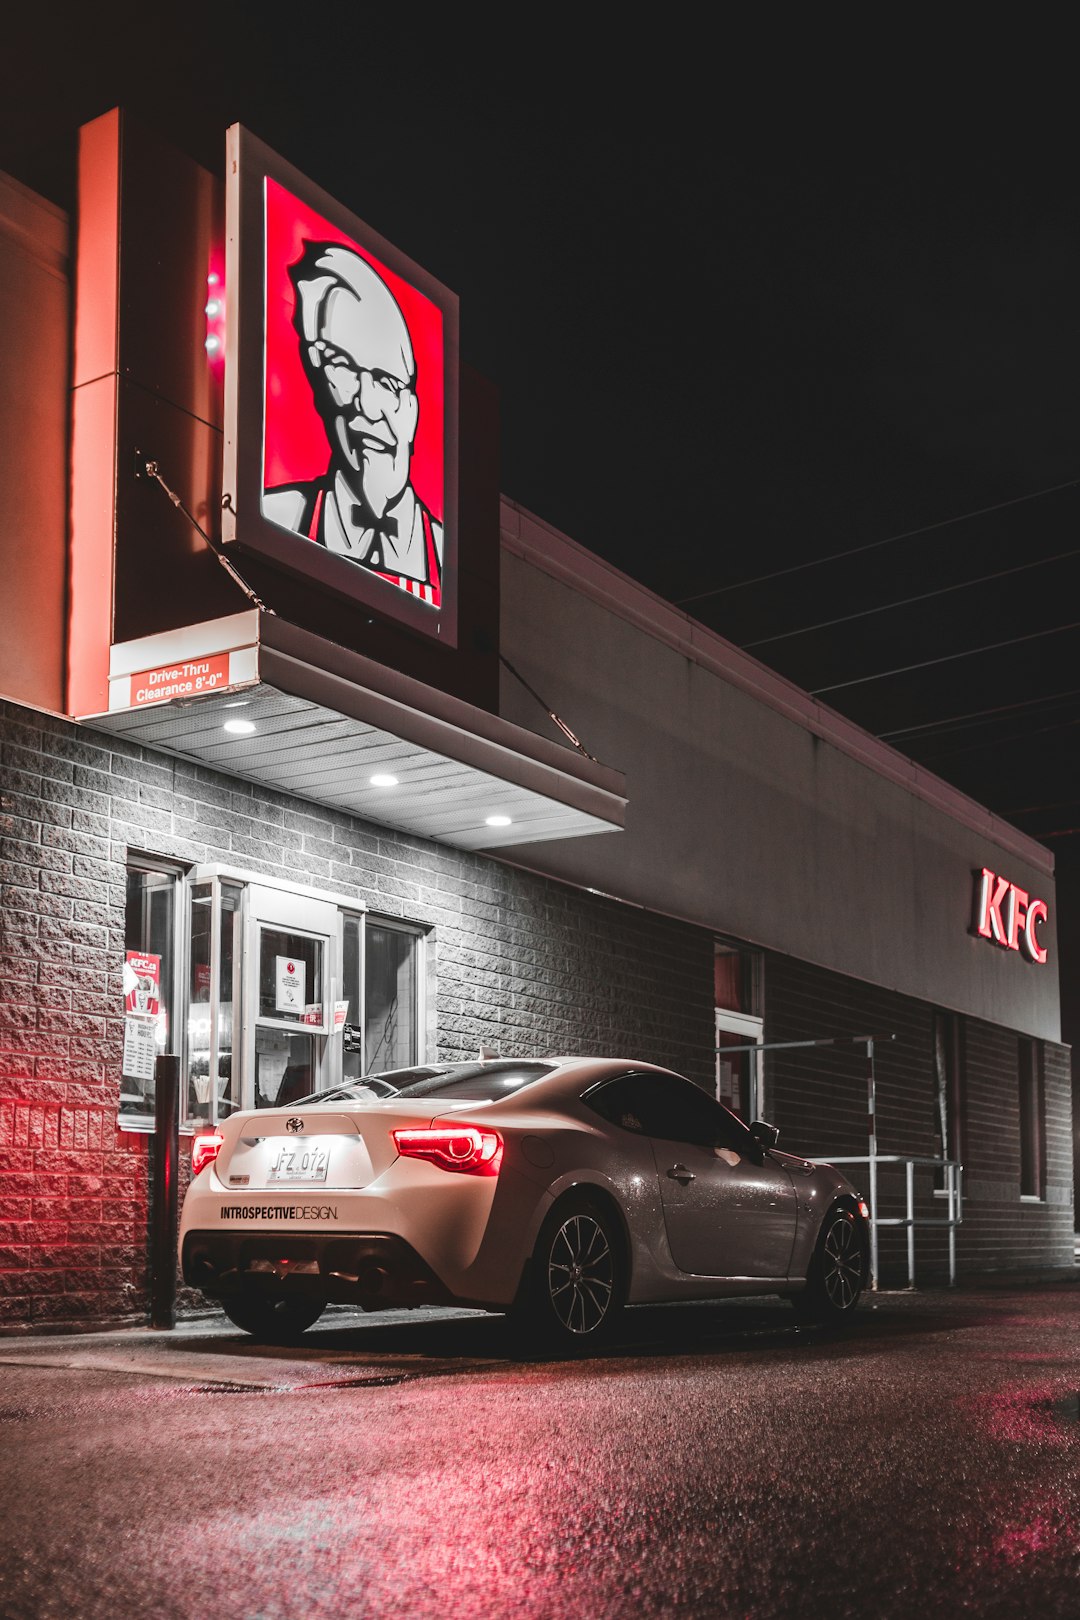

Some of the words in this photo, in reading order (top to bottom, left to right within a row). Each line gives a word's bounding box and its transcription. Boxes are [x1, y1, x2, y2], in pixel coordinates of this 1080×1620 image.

[149, 662, 210, 685] Drive-Thru
[136, 681, 193, 702] Clearance
[195, 672, 223, 690] 8'-0"
[978, 867, 1048, 964] KFC
[301, 1152, 326, 1172] 072
